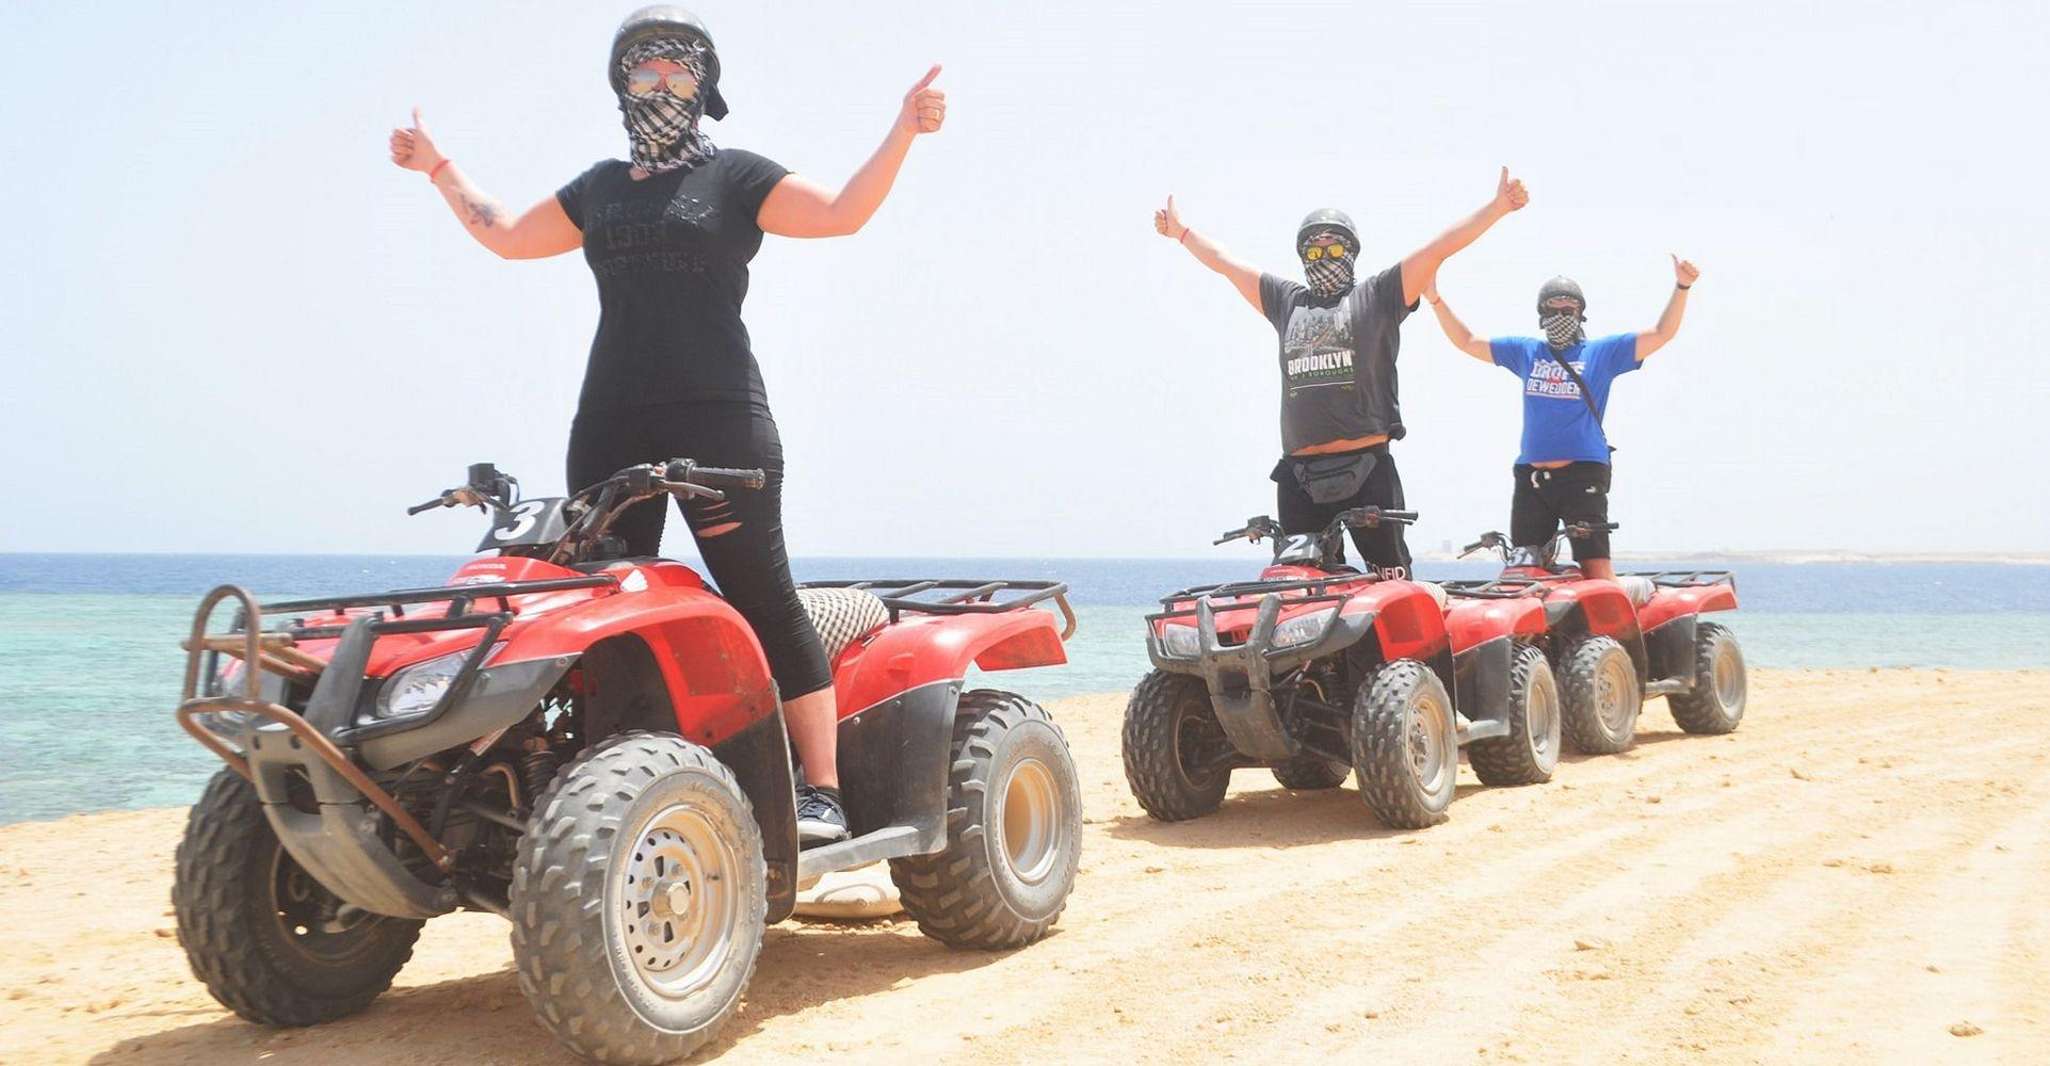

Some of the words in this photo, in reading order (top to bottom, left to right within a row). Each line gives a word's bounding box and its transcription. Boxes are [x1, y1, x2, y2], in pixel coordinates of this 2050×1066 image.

[1288, 350, 1352, 375] BROOKLYN
[494, 500, 545, 540] 3
[1279, 534, 1308, 559] 2
